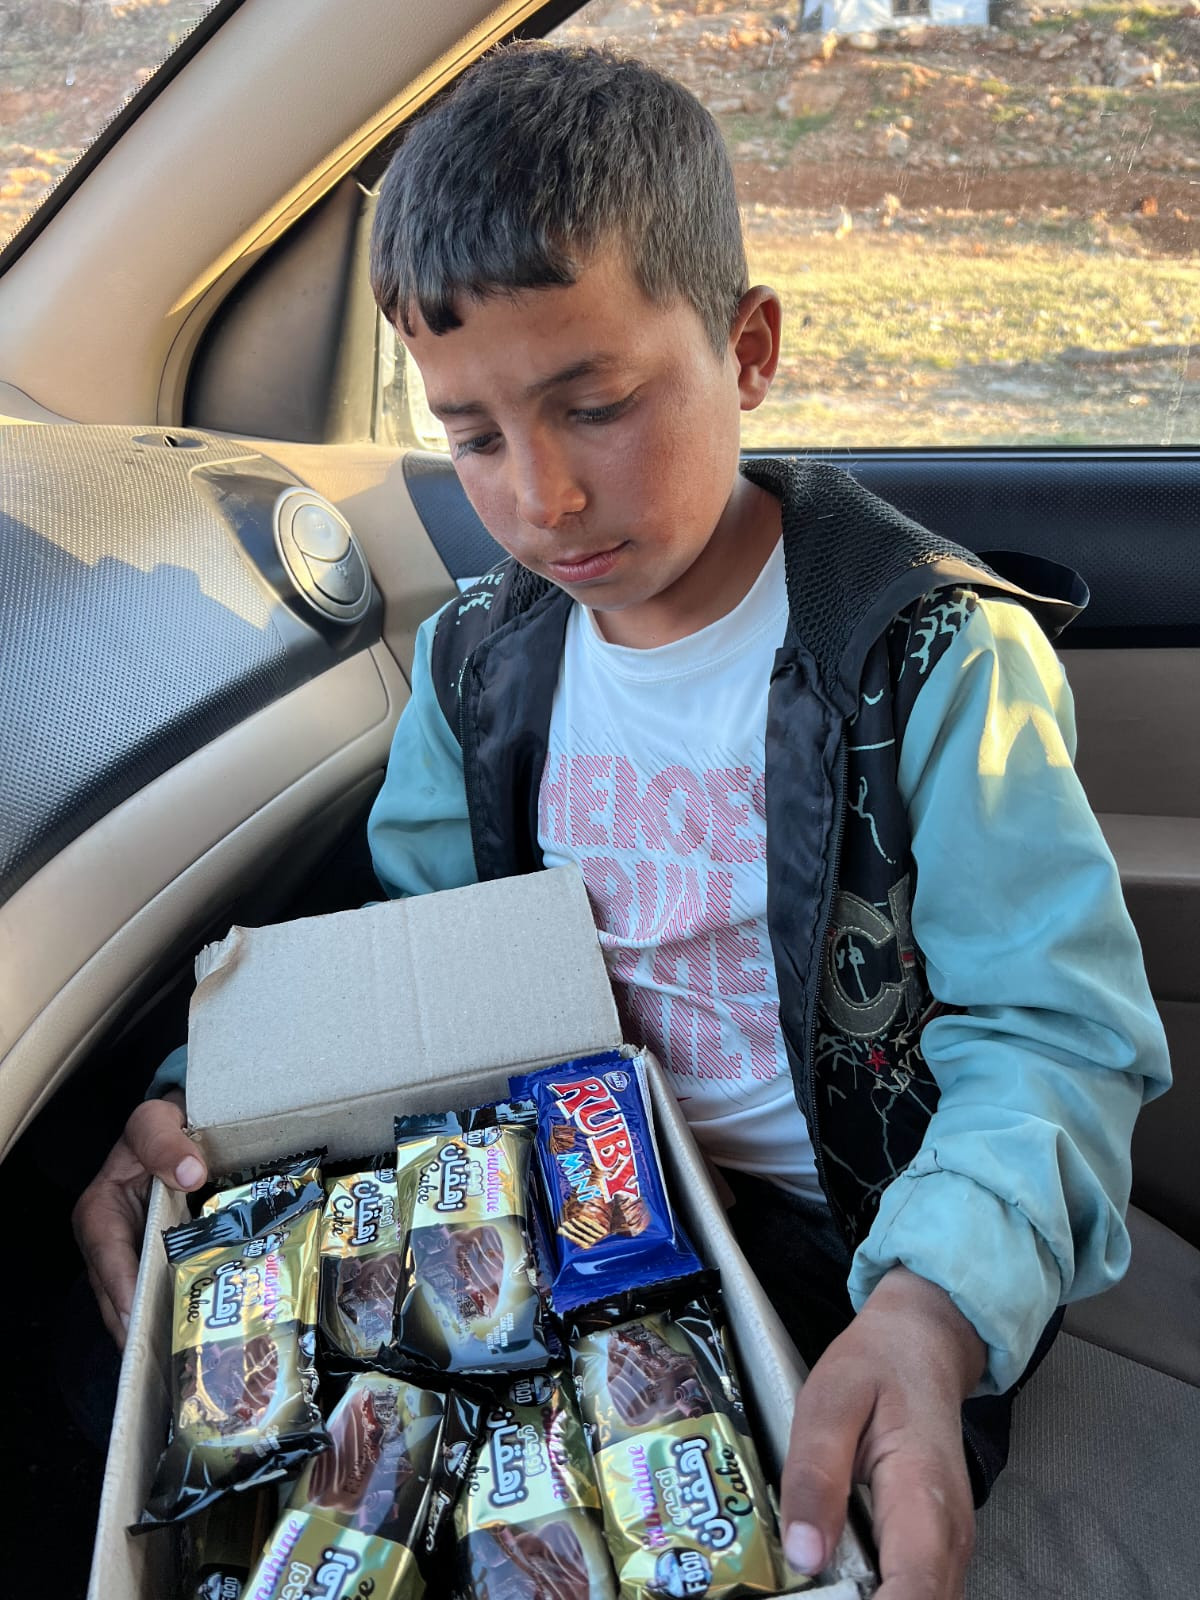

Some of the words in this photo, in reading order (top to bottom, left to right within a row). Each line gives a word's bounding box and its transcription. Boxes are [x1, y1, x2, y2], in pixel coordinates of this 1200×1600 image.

[548, 1076, 640, 1203] RUBY
[416, 1161, 440, 1205] Cake
[435, 1143, 465, 1211] زهقان
[486, 1146, 506, 1213] Sunshine
[331, 1195, 355, 1237] Cake
[350, 1182, 379, 1245] زهقان
[187, 1276, 214, 1324] Cake
[486, 1406, 525, 1505] زهقان
[715, 1444, 754, 1516] Cake
[627, 1444, 668, 1548] Sunshine
[674, 1437, 736, 1549] زهقان
[222, 1576, 238, 1600] OOD
[252, 1518, 305, 1600] nshine
[679, 1551, 709, 1594] FOOD
